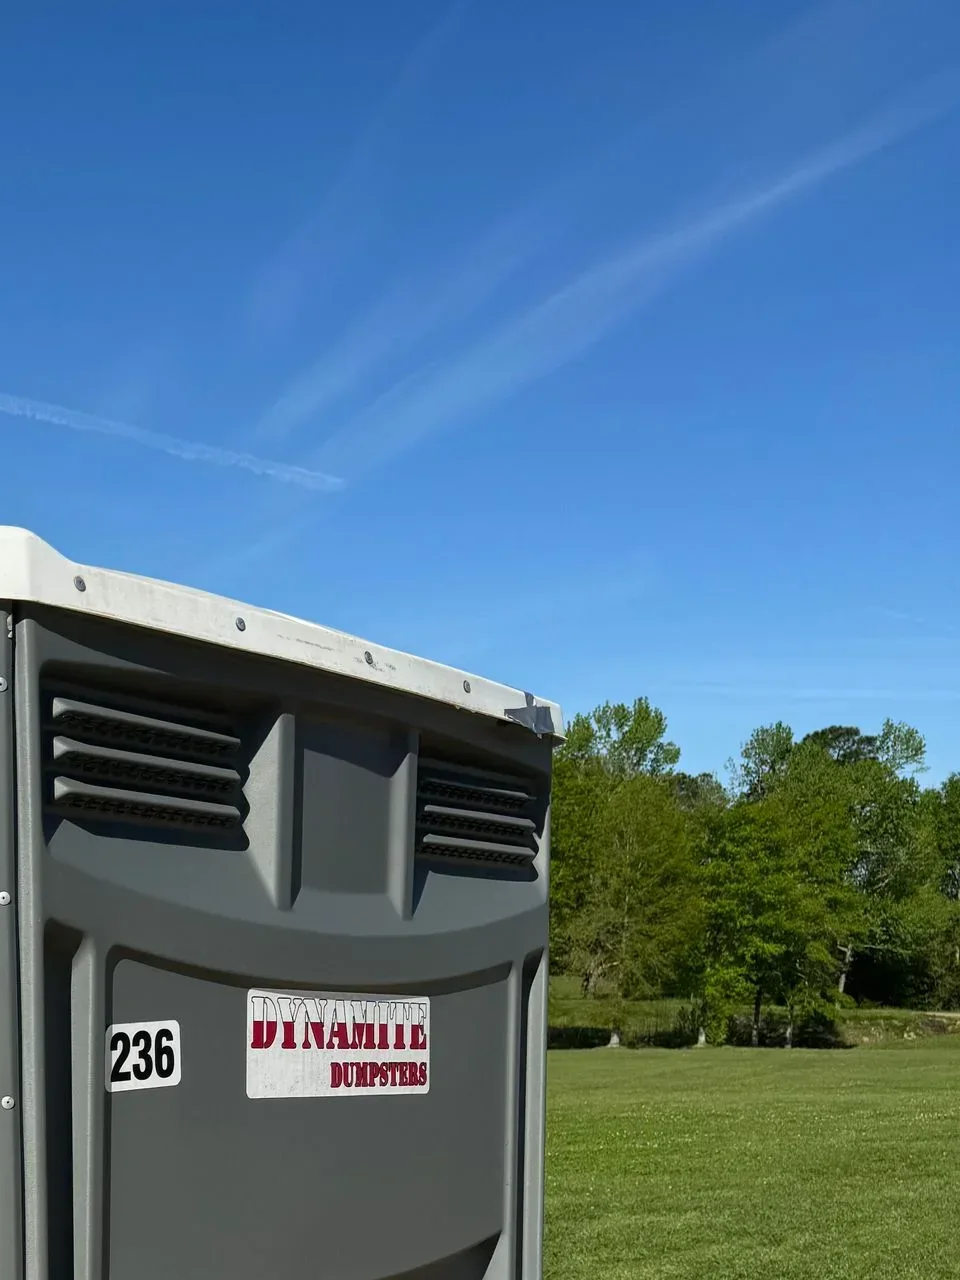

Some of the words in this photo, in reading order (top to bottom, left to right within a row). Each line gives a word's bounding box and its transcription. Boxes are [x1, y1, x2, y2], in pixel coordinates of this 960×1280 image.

[250, 996, 427, 1049] DYNAMITE
[109, 1028, 175, 1082] 236
[330, 1061, 427, 1088] DUMPSTERS
